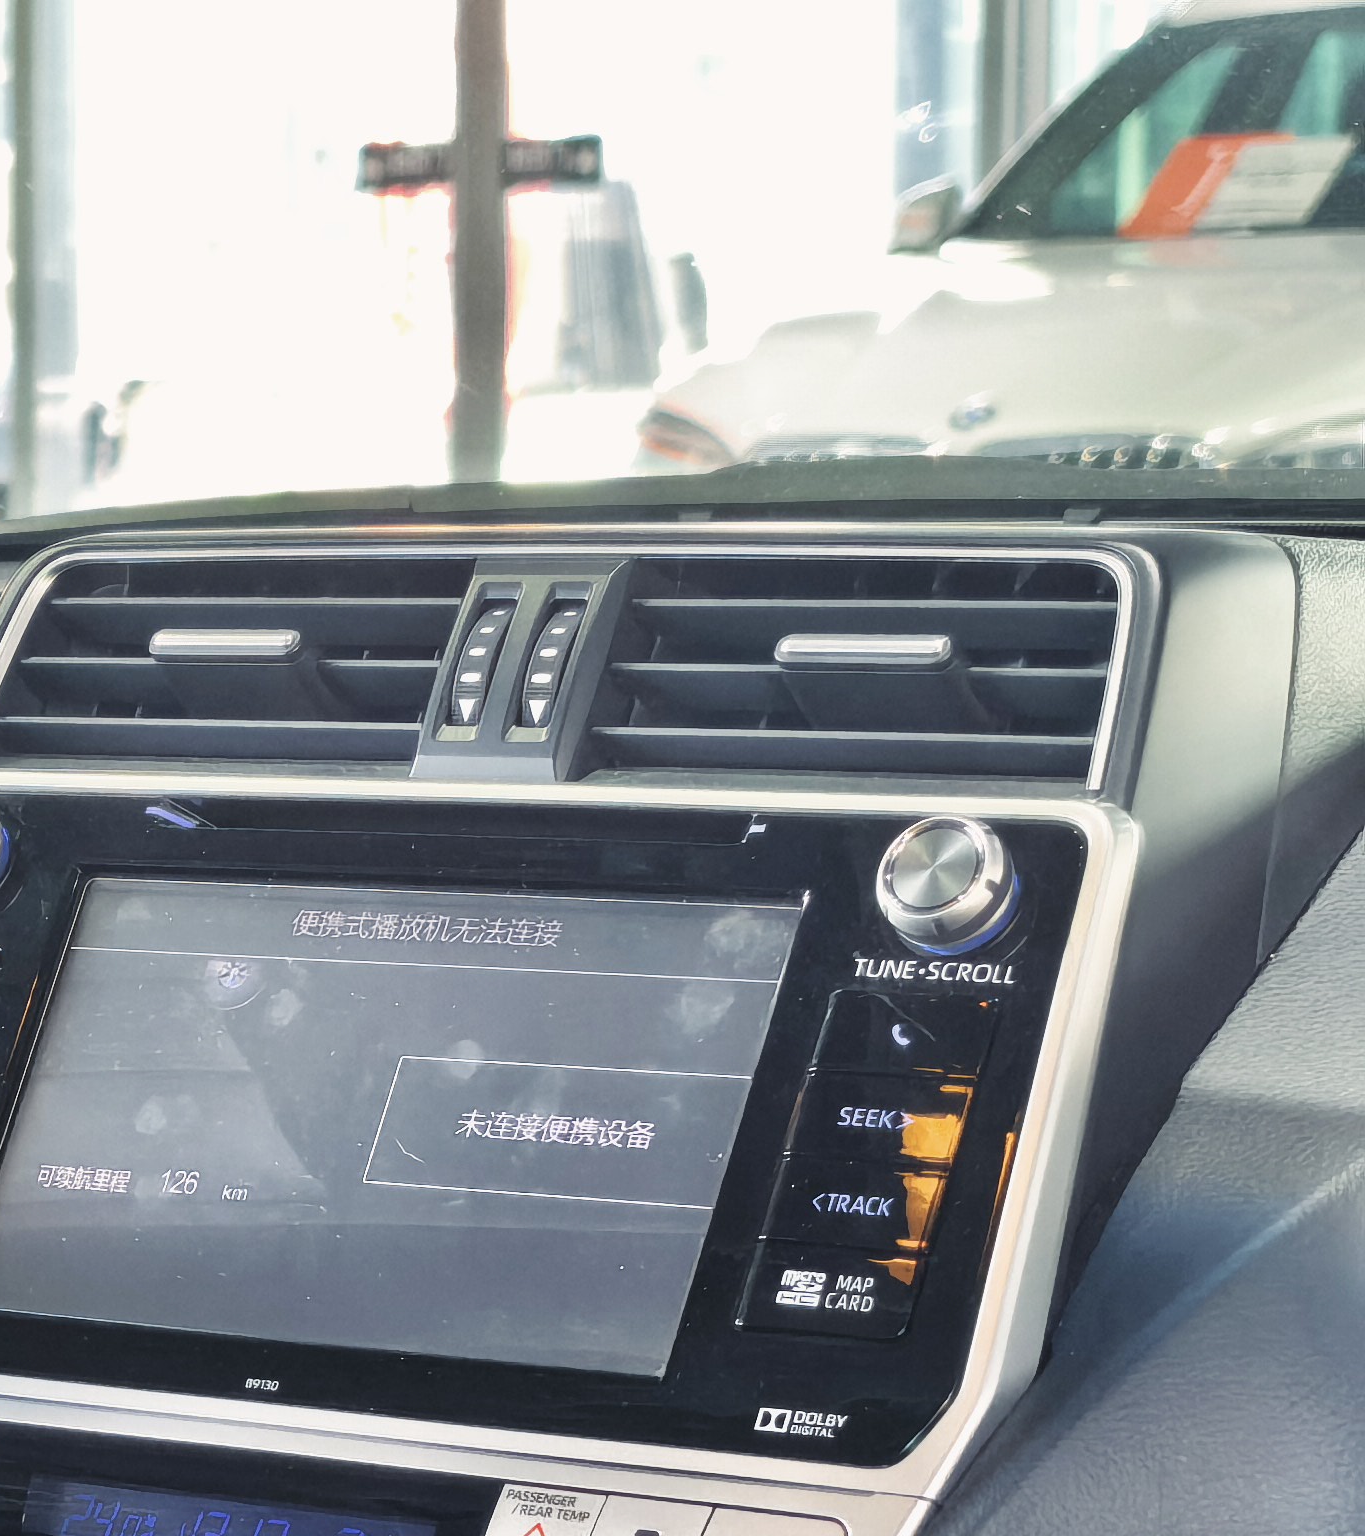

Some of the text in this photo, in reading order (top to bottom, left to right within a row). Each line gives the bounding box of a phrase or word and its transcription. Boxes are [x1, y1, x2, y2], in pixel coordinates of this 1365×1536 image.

[292, 909, 563, 948] 便携式播放机无法连接
[455, 1109, 656, 1150] 未连接便携设备
[37, 1163, 248, 1201] 可续航里程 126 km
[835, 1274, 874, 1293] MAP
[825, 1292, 874, 1312] CARD
[792, 1410, 848, 1428] DOLBY
[789, 1424, 835, 1438] DIGITAL
[506, 1488, 577, 1508] PASSENGER
[557, 1508, 591, 1523] TEMP
